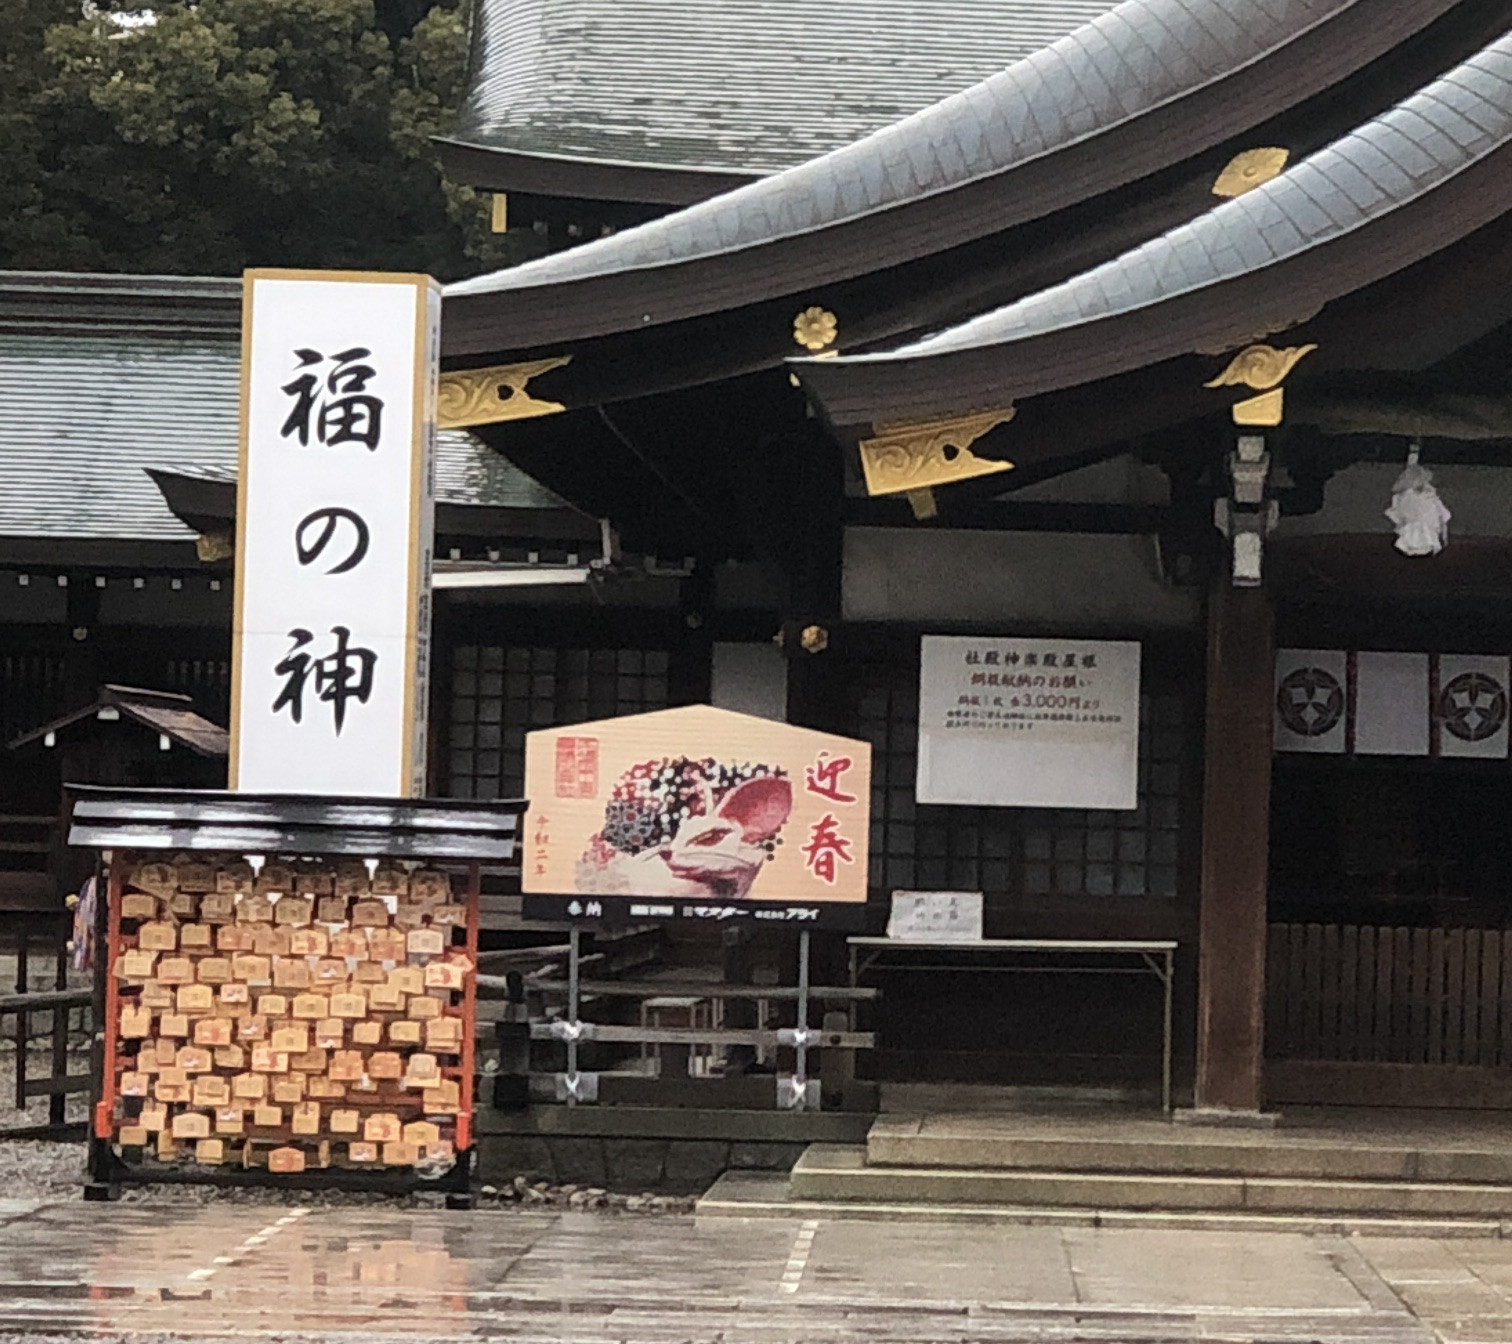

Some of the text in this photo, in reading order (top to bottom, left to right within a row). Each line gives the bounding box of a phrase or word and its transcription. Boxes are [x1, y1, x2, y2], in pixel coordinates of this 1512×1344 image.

[271, 347, 385, 738] 福の神
[801, 752, 857, 884] 迎春
